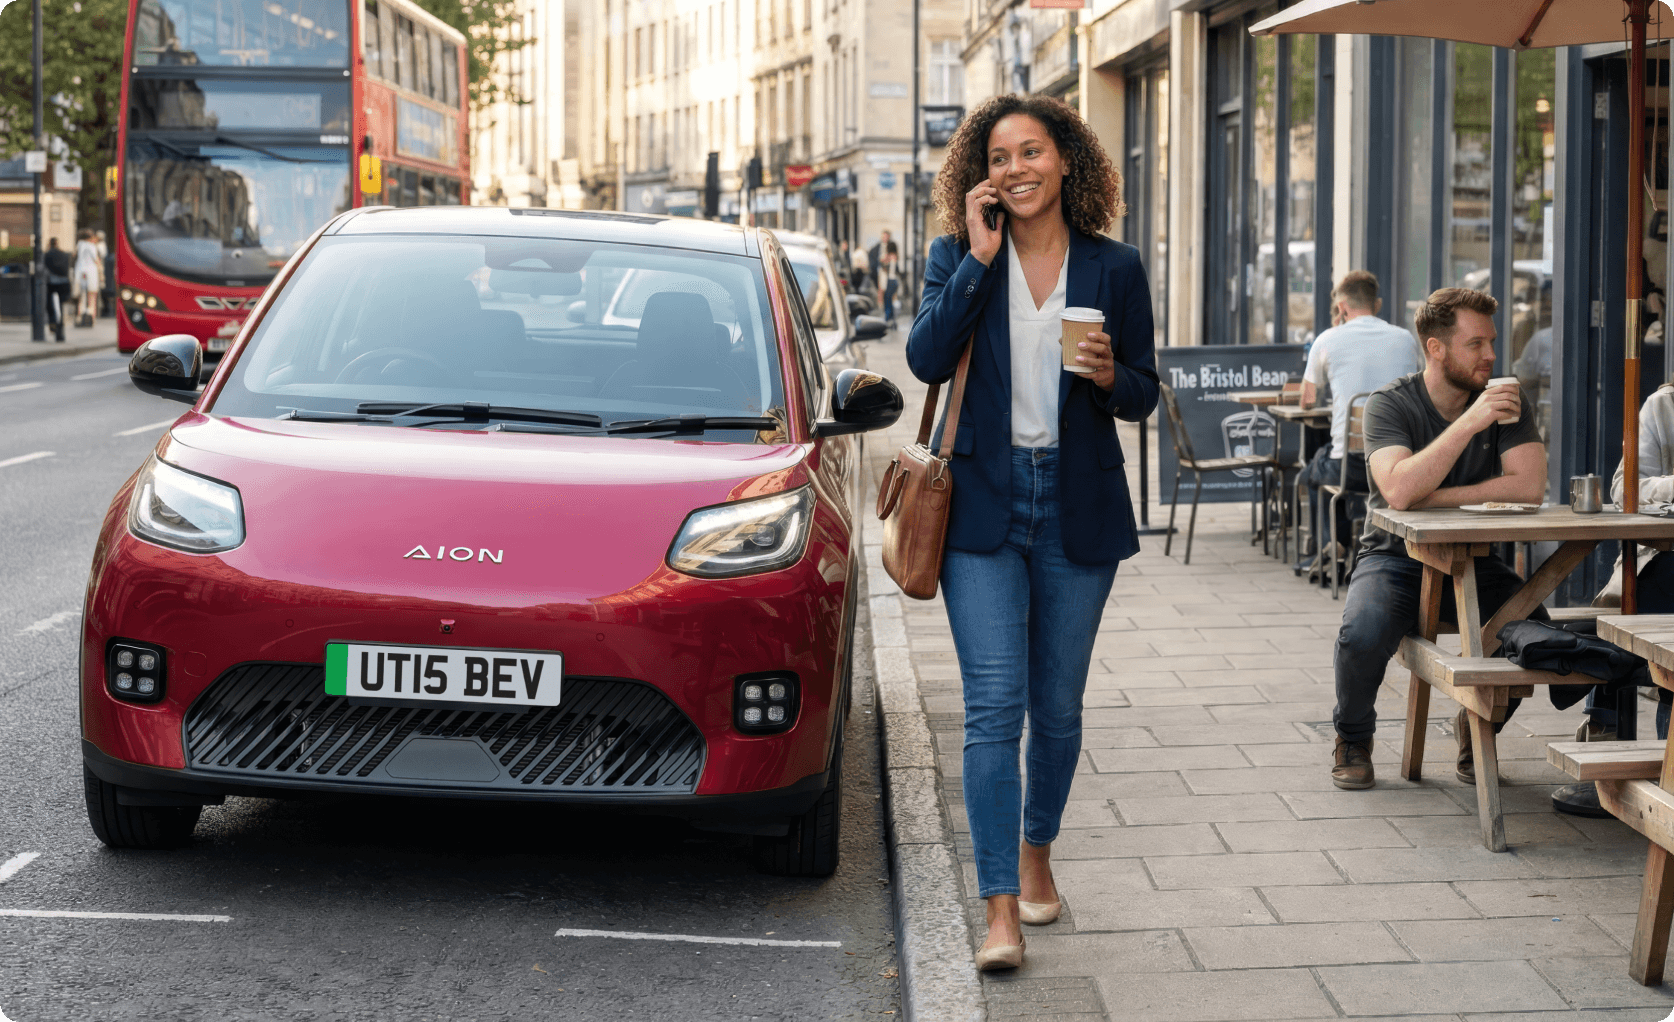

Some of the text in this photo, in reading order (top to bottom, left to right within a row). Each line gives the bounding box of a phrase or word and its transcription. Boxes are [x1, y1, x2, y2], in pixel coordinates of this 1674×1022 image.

[1169, 365, 1289, 389] The Bristol Bean
[403, 545, 504, 564] AION
[463, 656, 545, 700] BEV
